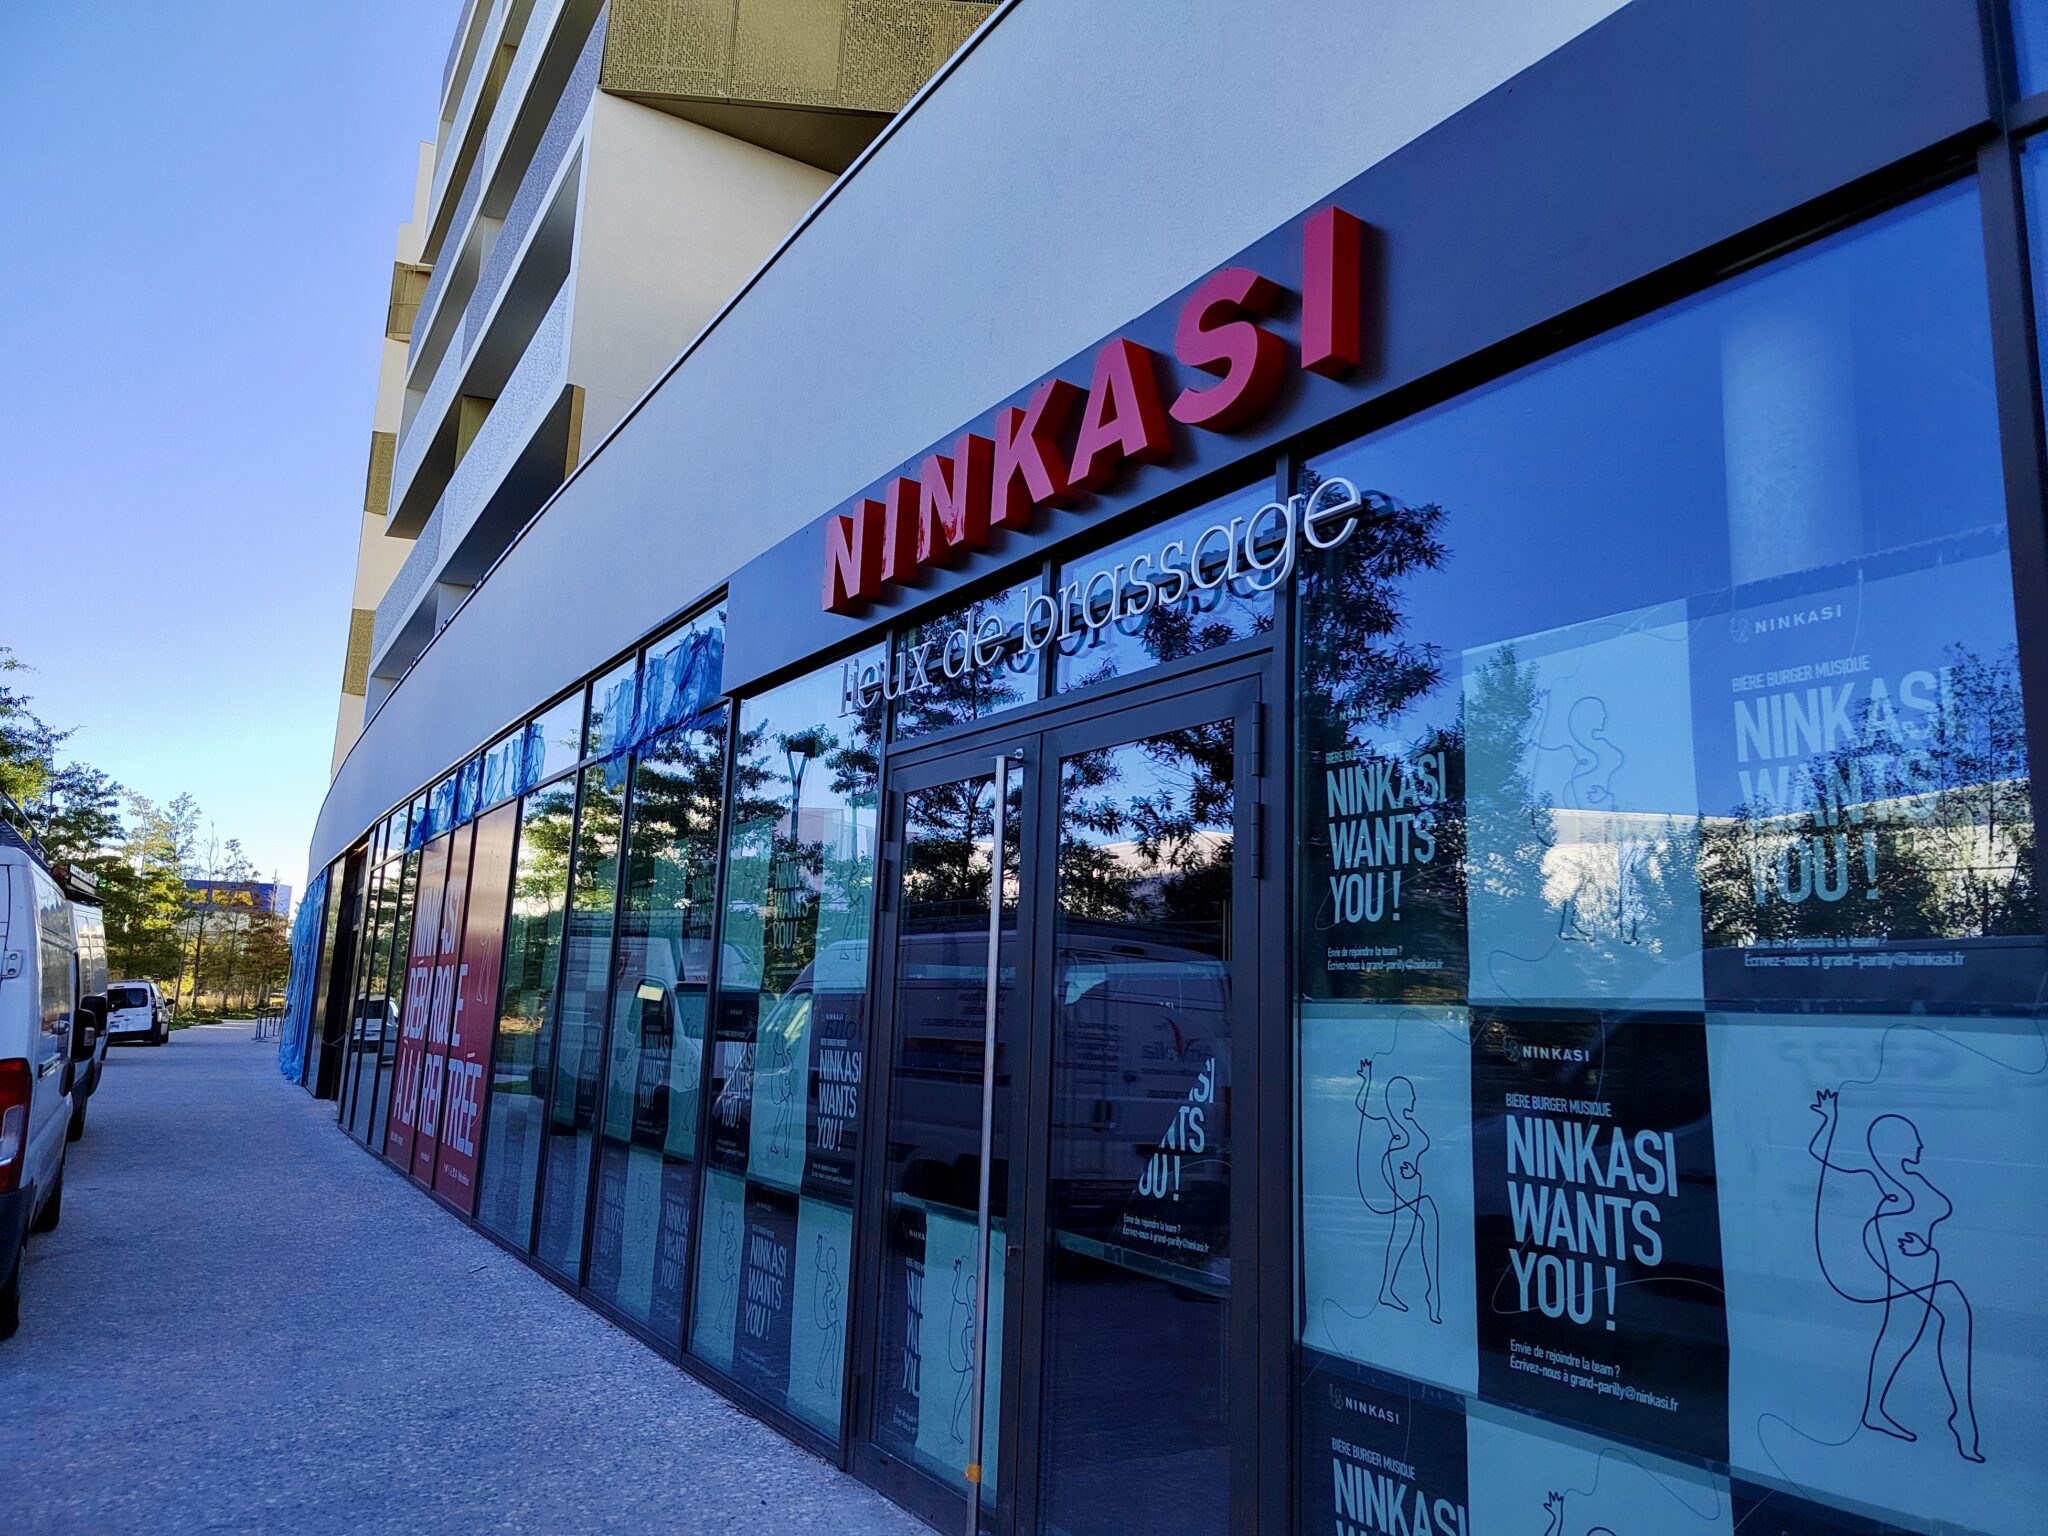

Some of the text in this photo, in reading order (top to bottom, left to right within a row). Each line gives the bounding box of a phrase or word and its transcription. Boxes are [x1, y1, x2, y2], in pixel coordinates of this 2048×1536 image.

[822, 204, 1362, 615] NINKASI
[839, 475, 1362, 718] lieux de brassage
[1755, 604, 1842, 634] NINKASI
[1766, 664, 1814, 687] BURGER
[1815, 655, 1871, 678] MUSIQUE
[1733, 666, 1957, 763] NINKASI
[1327, 751, 1447, 818] NINKASI
[1328, 811, 1437, 870] WANTS
[819, 1048, 863, 1084] NINKASI
[1522, 1046, 1590, 1062] NINKASI
[818, 1083, 858, 1119] WANTS
[1532, 1095, 1568, 1113] BURGER
[1569, 1099, 1613, 1118] MUSIQUE
[1506, 1114, 1679, 1198] NINKASI
[1507, 1180, 1664, 1267] WANTS
[750, 1233, 787, 1279] NINKASI
[748, 1268, 783, 1311] WANTS
[1510, 1338, 1532, 1356] Envie
[1533, 1345, 1544, 1358] de
[1545, 1348, 1581, 1369] rejoindre
[1582, 1356, 1590, 1371] la
[1509, 1353, 1680, 1413] Écrivez-nous à grand-parilly@ninkasi.fr
[1345, 1396, 1400, 1425] NINKASI
[1352, 1444, 1382, 1467] BURGER
[1383, 1455, 1416, 1480] MUSIQUE
